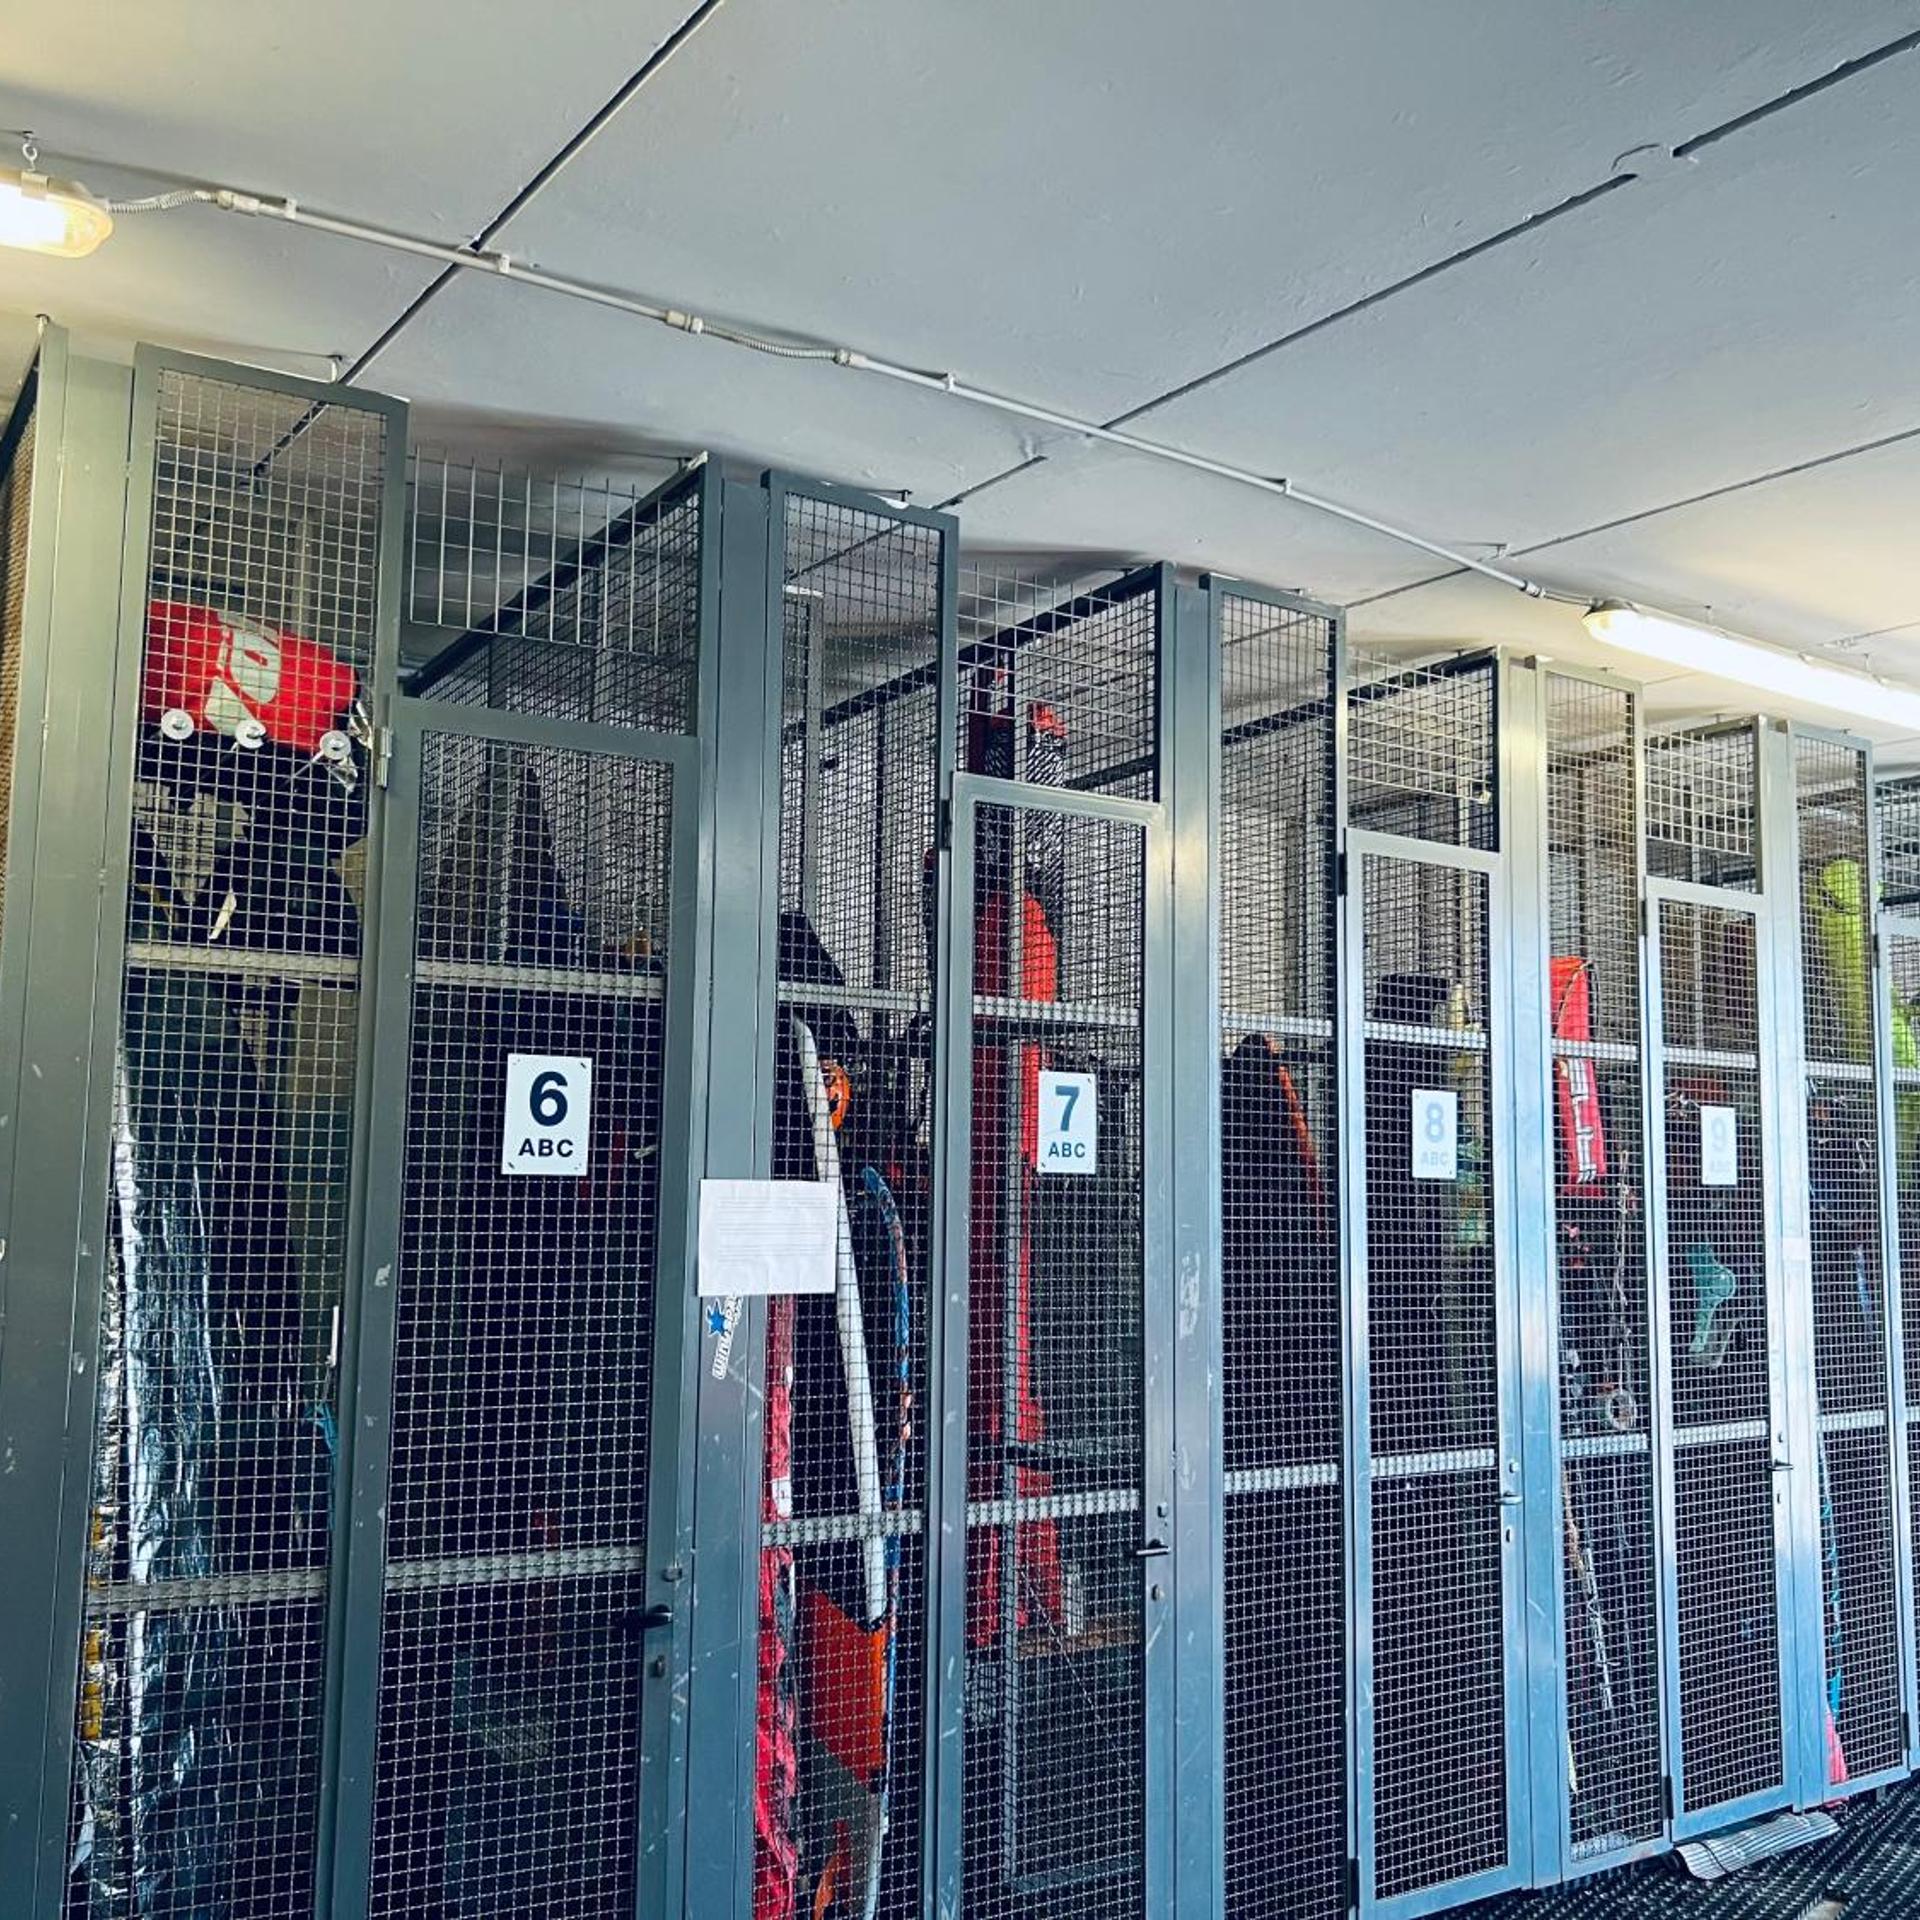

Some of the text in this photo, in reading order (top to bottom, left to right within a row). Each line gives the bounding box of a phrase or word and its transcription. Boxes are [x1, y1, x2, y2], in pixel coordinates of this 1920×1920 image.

[529, 1071, 568, 1126] 6
[1055, 1085, 1080, 1132] 7
[1425, 1103, 1444, 1143] 8
[1711, 1117, 1727, 1153] 9
[518, 1138, 574, 1158] ABC
[1048, 1141, 1086, 1158] ABC
[1420, 1151, 1449, 1167] ABC
